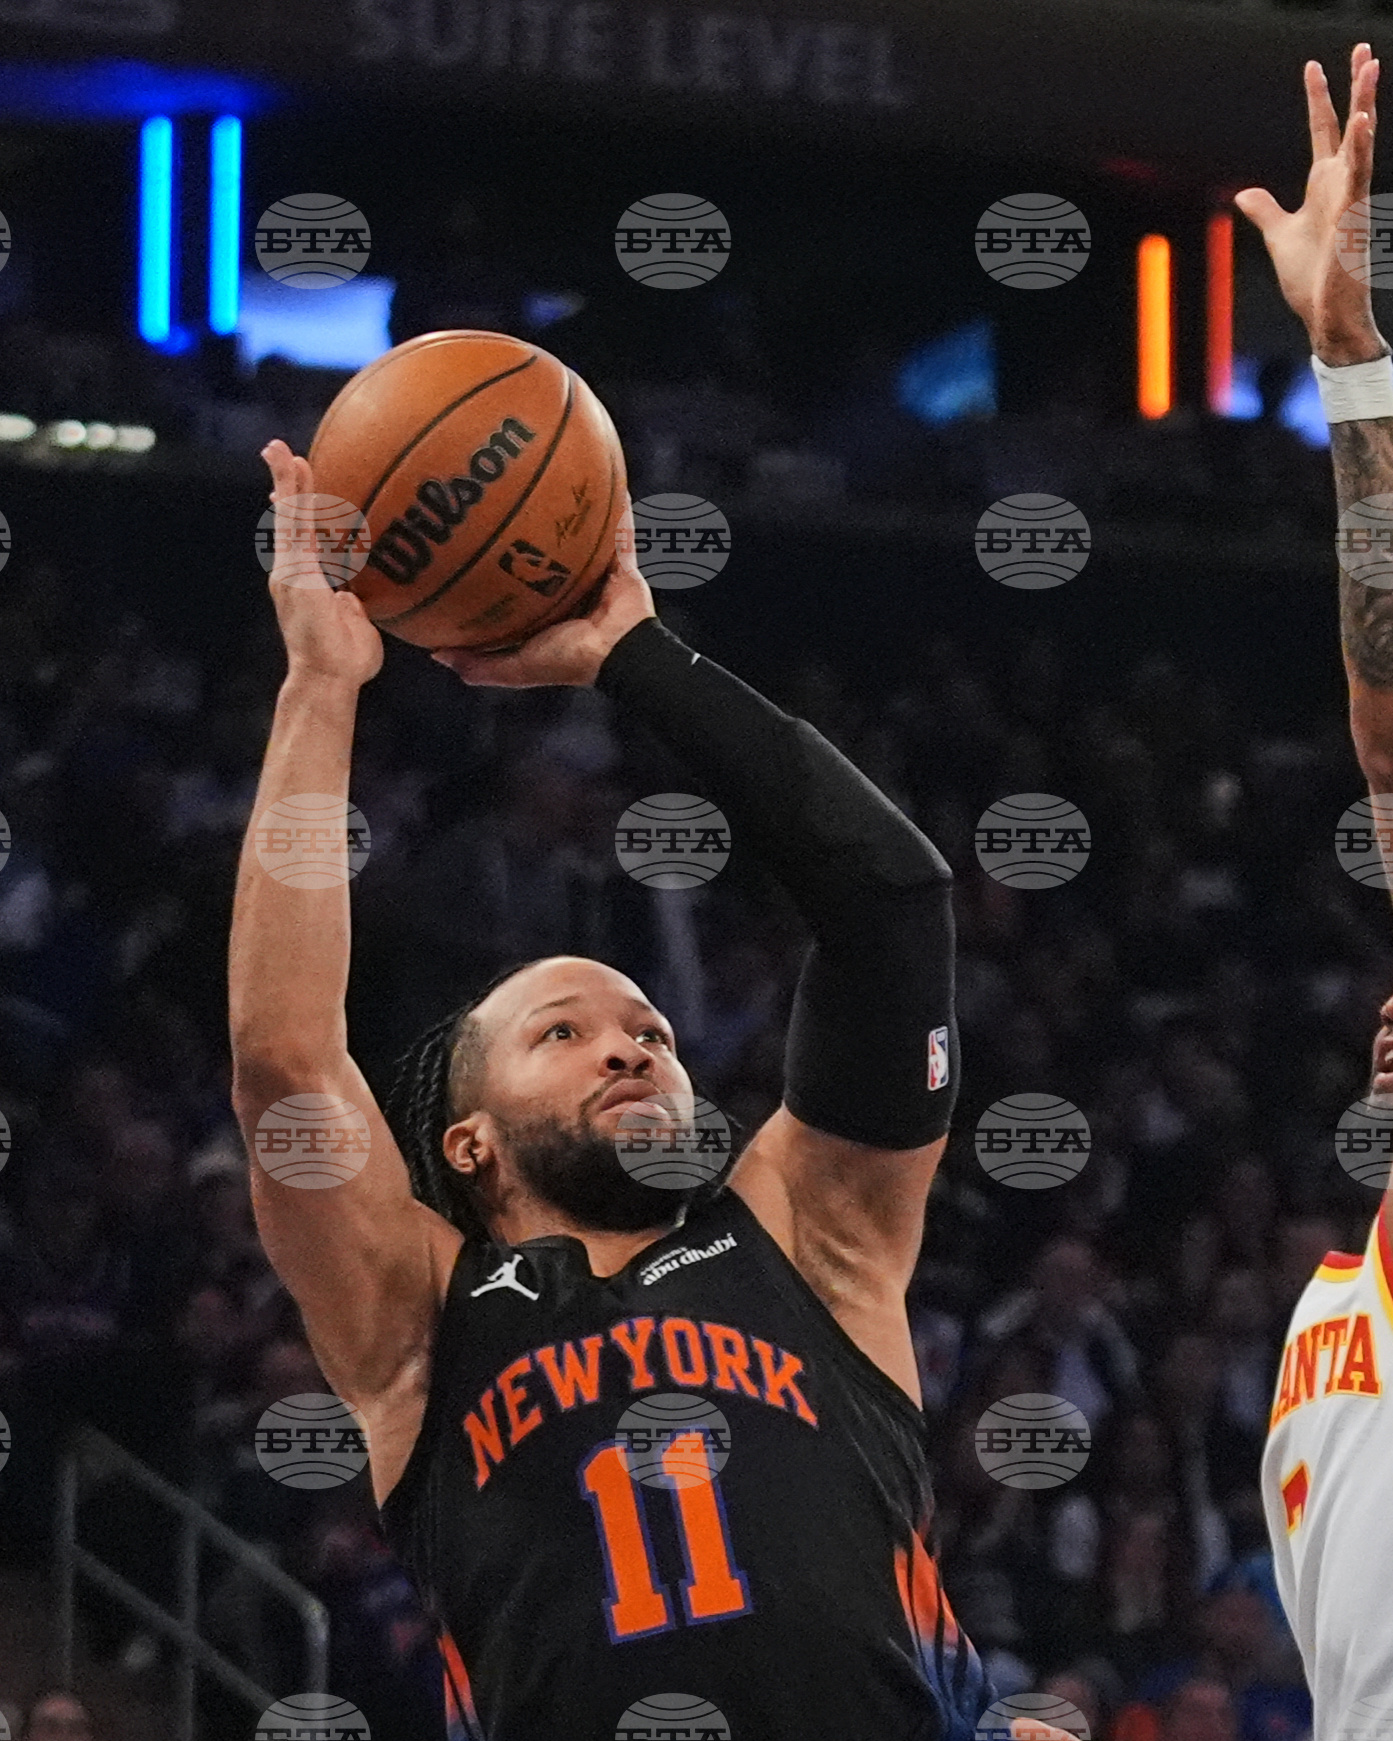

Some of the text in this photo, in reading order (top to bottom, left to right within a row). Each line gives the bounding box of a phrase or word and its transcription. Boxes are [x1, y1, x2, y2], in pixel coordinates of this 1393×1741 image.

[641, 11, 912, 108] LEVEL
[367, 416, 536, 586] Wilson
[643, 1259, 680, 1286] abu
[680, 1232, 738, 1265] dhabi
[462, 1315, 820, 1490] NEW YORK
[1269, 1311, 1382, 1433] ANTA
[576, 1423, 753, 1645] 11
